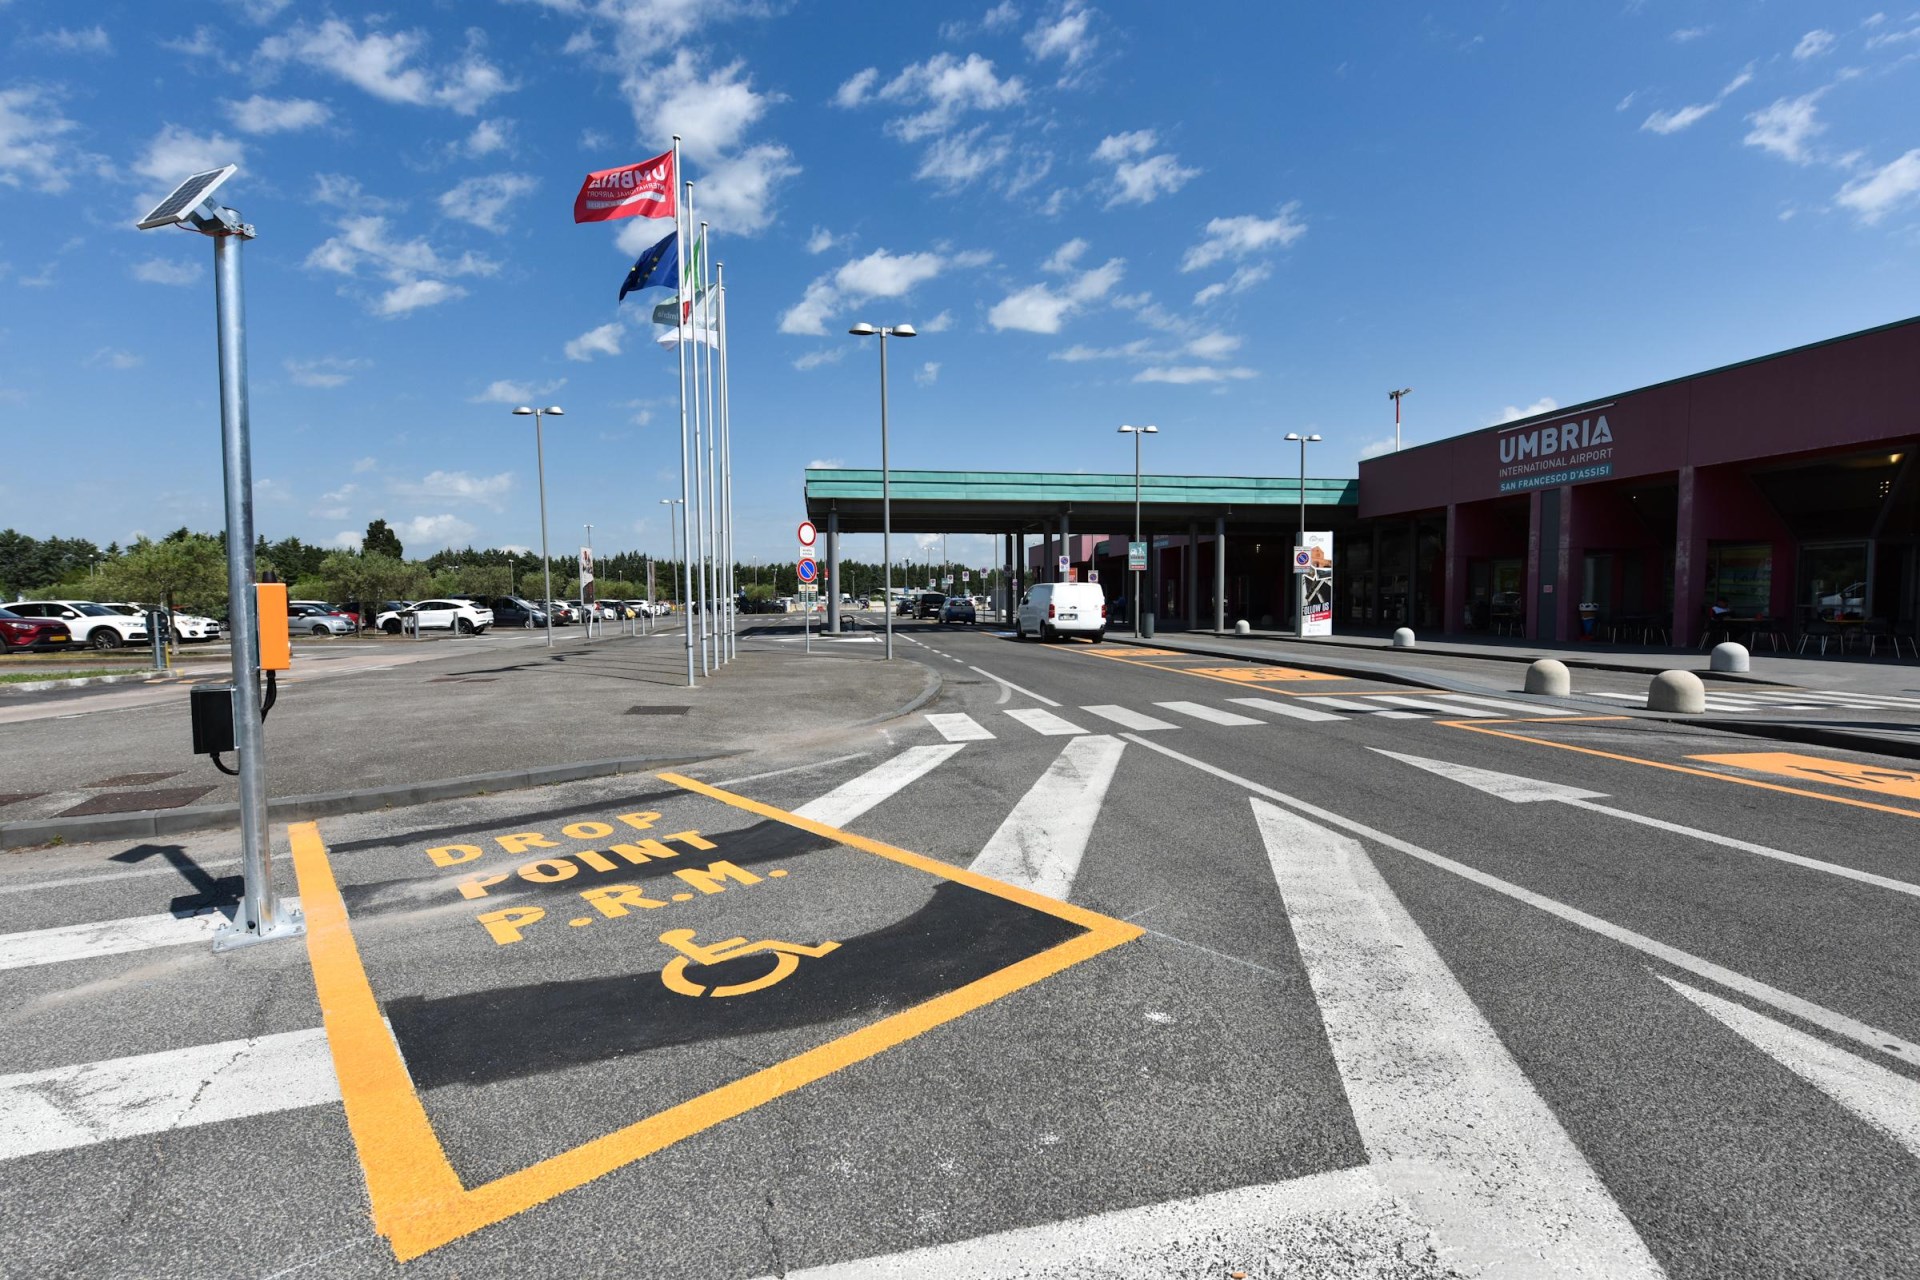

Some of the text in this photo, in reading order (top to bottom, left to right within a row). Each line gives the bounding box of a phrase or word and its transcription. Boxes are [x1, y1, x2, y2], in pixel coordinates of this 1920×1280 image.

[1500, 415, 1613, 464] UMBRIA
[1500, 447, 1613, 477] INTERNATIONAL AIRPORT
[1500, 466, 1609, 492] SAN FRANCESCO D'ASSISI
[425, 811, 662, 867] DROP
[455, 830, 717, 900] POINT
[476, 860, 788, 945] P.R.M.
